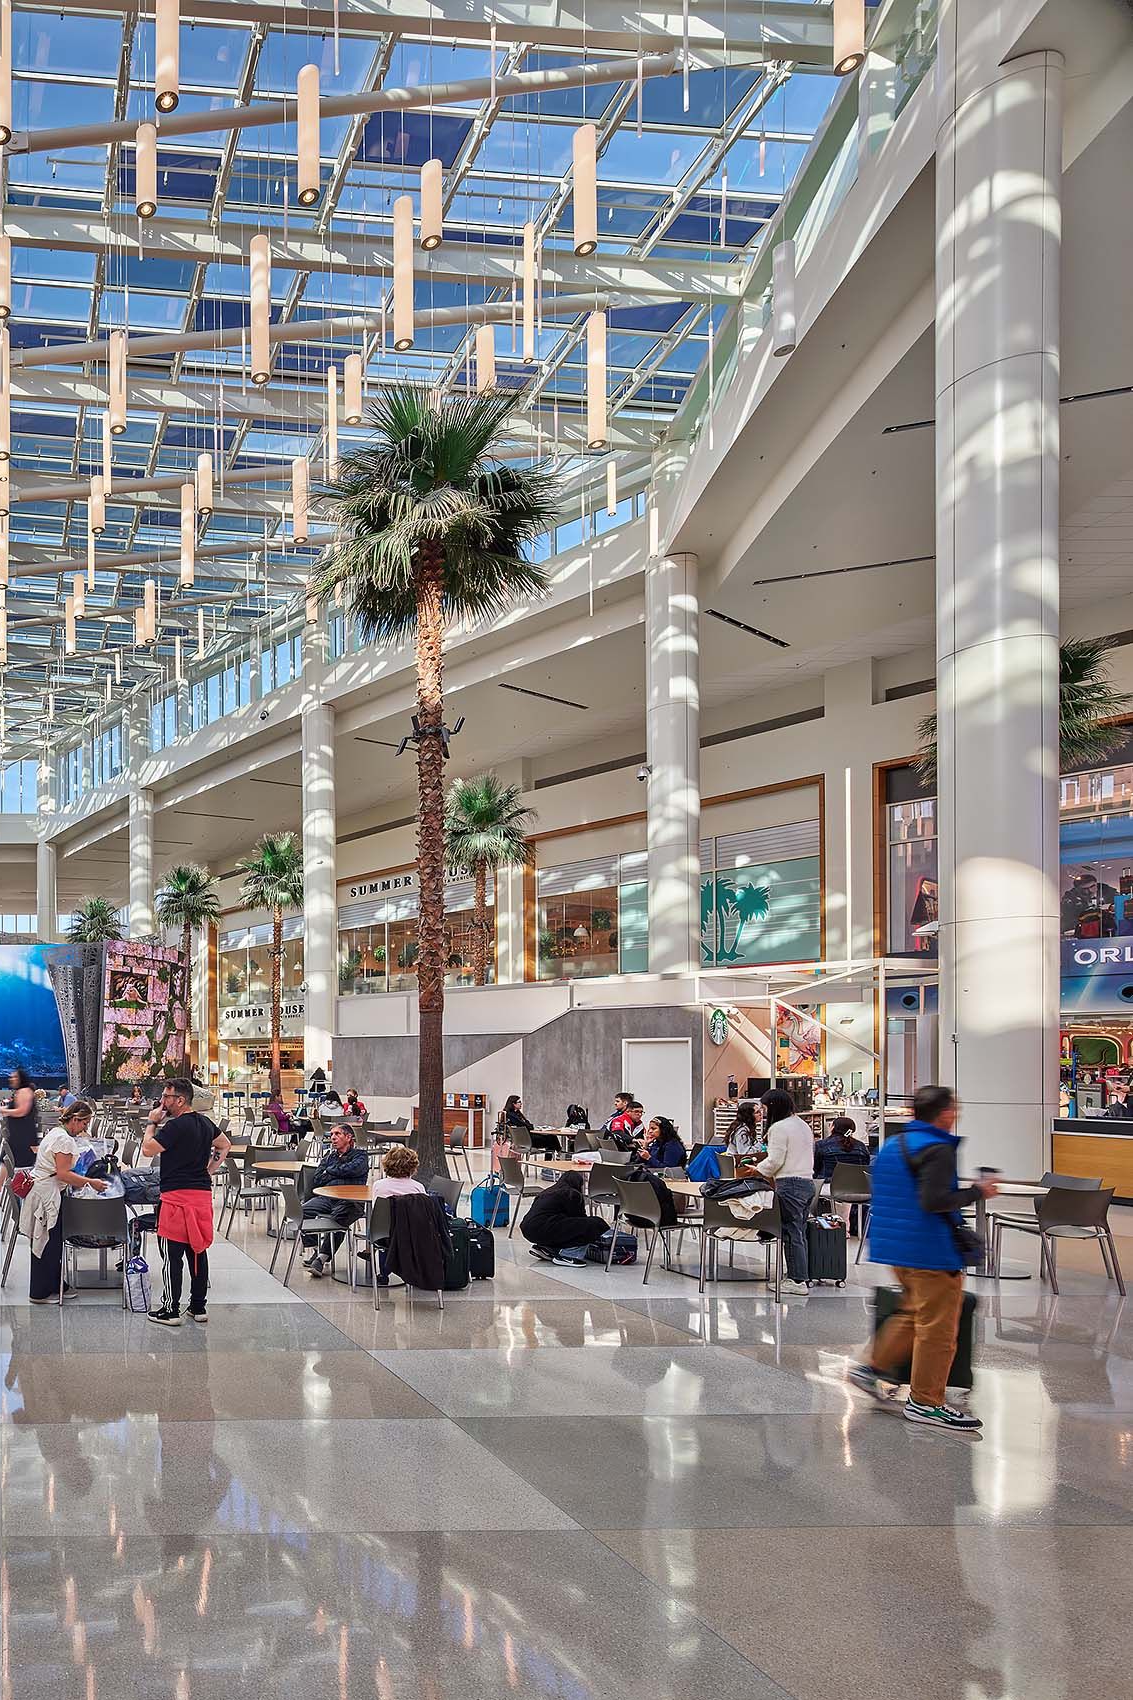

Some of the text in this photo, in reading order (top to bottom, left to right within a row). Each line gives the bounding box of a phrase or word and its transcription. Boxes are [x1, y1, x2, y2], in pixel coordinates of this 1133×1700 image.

[350, 876, 412, 898] SUMMER
[1074, 946, 1133, 964] ORL
[226, 1008, 264, 1019] SUMMER
